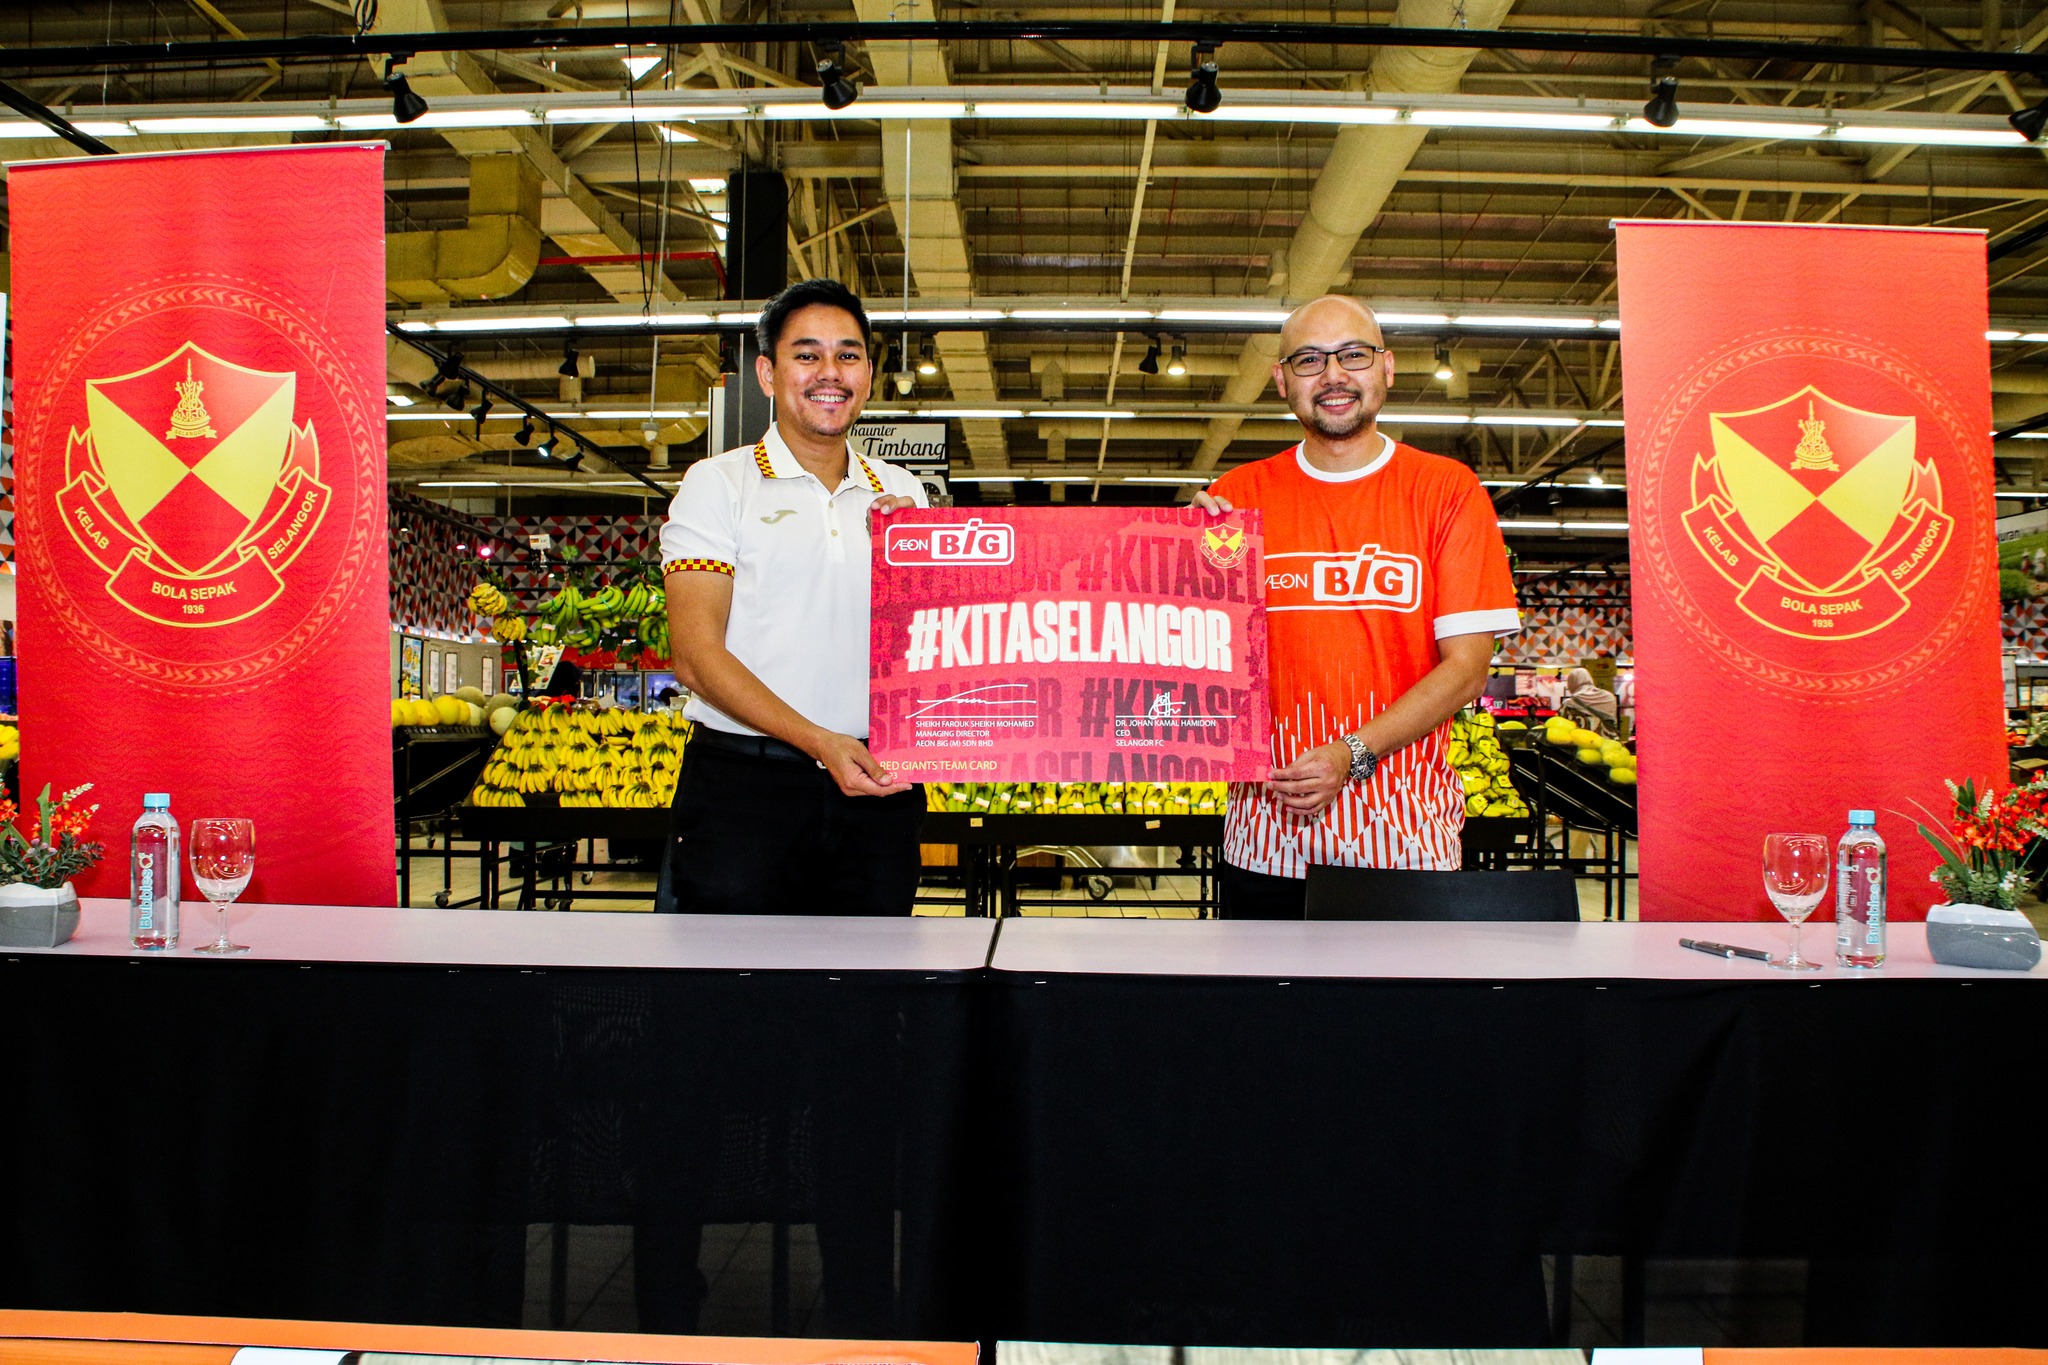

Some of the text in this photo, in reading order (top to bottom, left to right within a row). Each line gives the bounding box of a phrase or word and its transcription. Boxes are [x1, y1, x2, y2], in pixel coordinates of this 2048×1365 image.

[850, 423, 897, 437] Kaunter
[862, 437, 945, 460] Timbang
[74, 506, 110, 551] KELAB
[266, 490, 318, 560] SELANGOR
[1702, 525, 1740, 567] KELAB
[1891, 518, 1942, 581] SELANGOR
[151, 580, 238, 601] BOLA SEPAK
[181, 604, 205, 615] 1936
[1780, 596, 1863, 616] BOLA SEPAK
[1811, 618, 1834, 628] 1936
[905, 601, 1232, 672] #KITASELANGOR
[915, 720, 1035, 728] SHEIKH FAROUK SHEIKH MOHAMED
[949, 740, 961, 748] (M)
[1115, 739, 1164, 747] SELANGOR FC
[880, 760, 998, 771] RED GIANTS TEAM CARD
